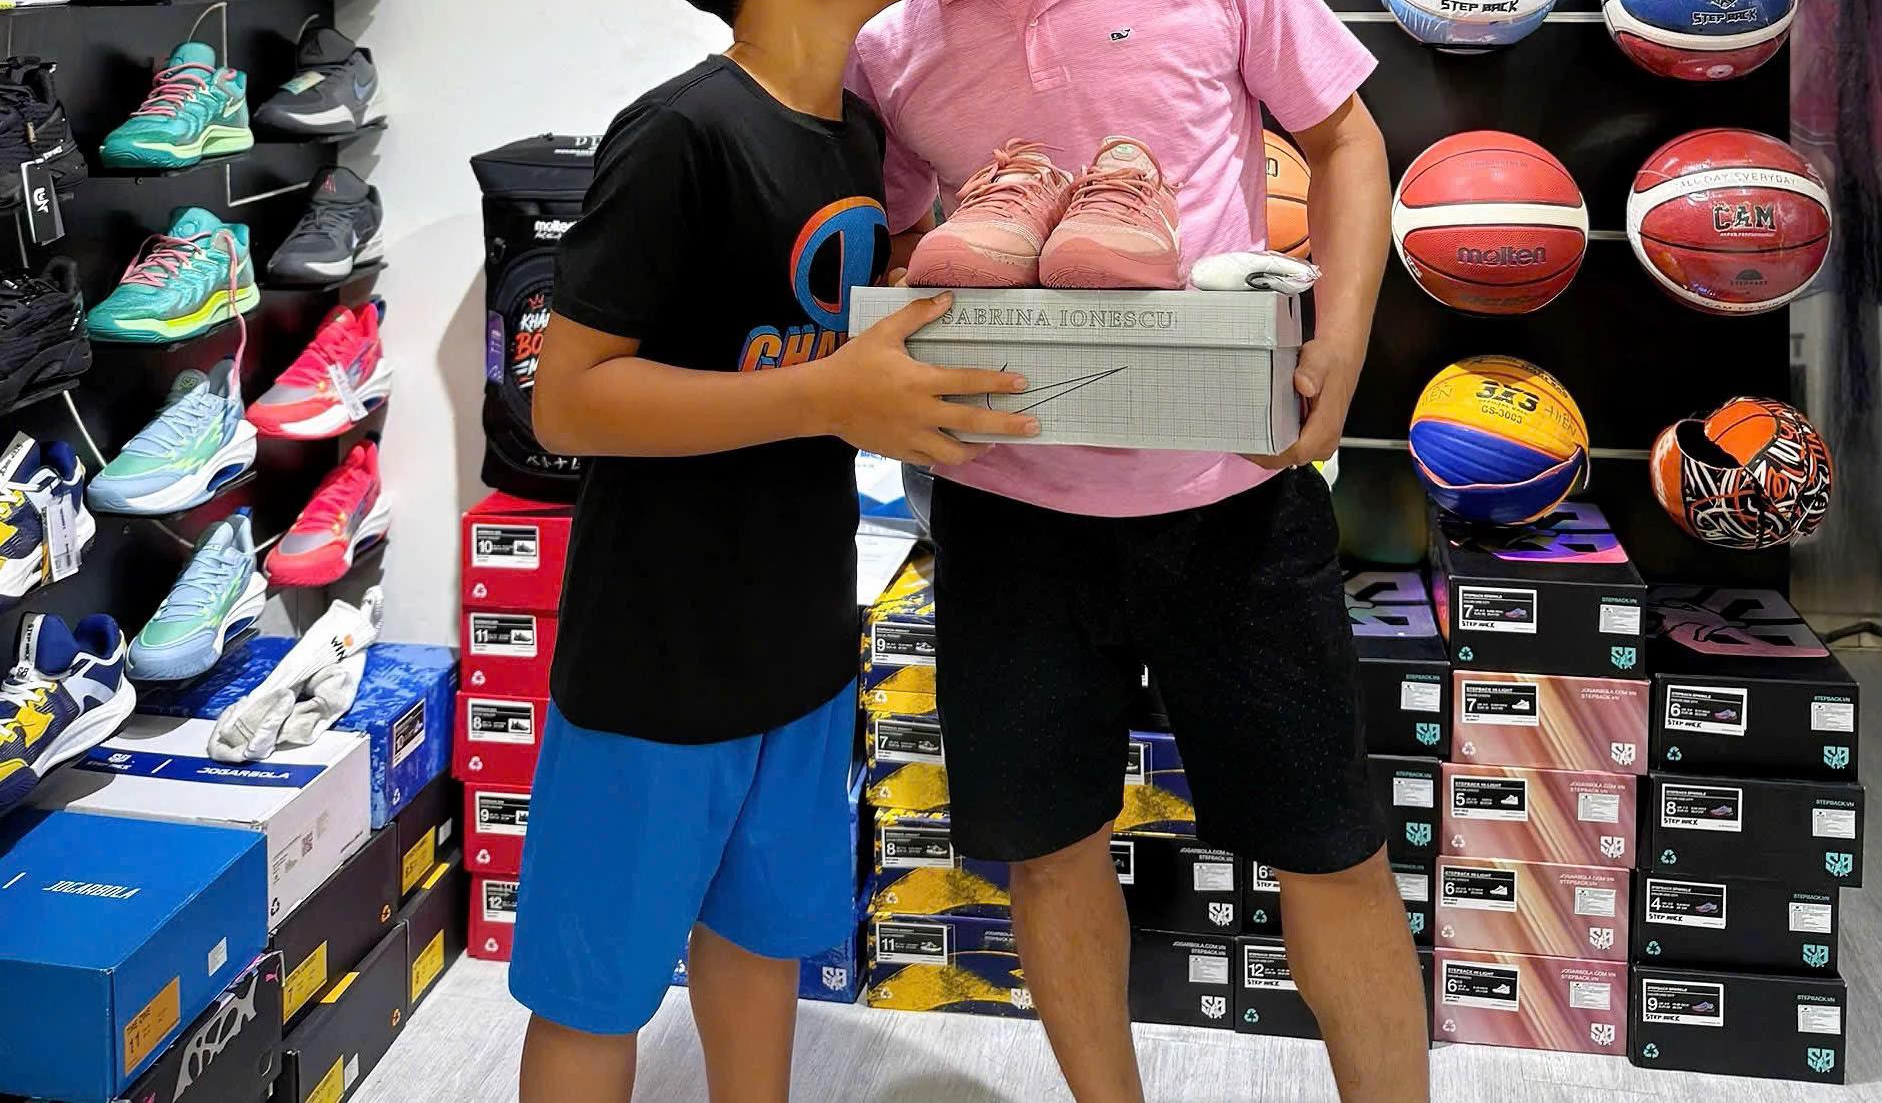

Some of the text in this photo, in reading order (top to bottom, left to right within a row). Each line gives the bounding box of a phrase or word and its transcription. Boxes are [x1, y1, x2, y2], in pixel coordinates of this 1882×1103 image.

[1482, 0, 1520, 13] BACK
[1692, 8, 1758, 26] STEP BACK
[1712, 203, 1777, 232] CAM
[1457, 246, 1548, 267] molten
[942, 307, 1175, 329] SABRINA IONESCU
[738, 324, 853, 373] CHA
[1475, 380, 1541, 413] 3X3
[478, 540, 493, 554] 10
[1463, 604, 1474, 619] 7
[475, 629, 489, 643] 11
[331, 635, 348, 664] WIN
[877, 638, 886, 652] 9
[1467, 698, 1477, 712] 7
[1670, 702, 1681, 717] 6
[473, 716, 482, 730] 8
[879, 735, 889, 749] 7
[196, 767, 292, 780] JOGARBOLA
[1456, 792, 1466, 806] 5
[1665, 800, 1676, 815] 8
[480, 808, 490, 822] 9
[886, 842, 896, 856] 8
[1258, 865, 1269, 879] 6
[42, 880, 142, 899] JOGARBOLA
[1444, 881, 1455, 895] 6
[488, 896, 503, 909] 12
[1650, 896, 1661, 911] 4
[881, 938, 895, 952] 11
[1248, 963, 1265, 978] 12
[1447, 979, 1458, 993] 6
[1647, 997, 1658, 1011] 9
